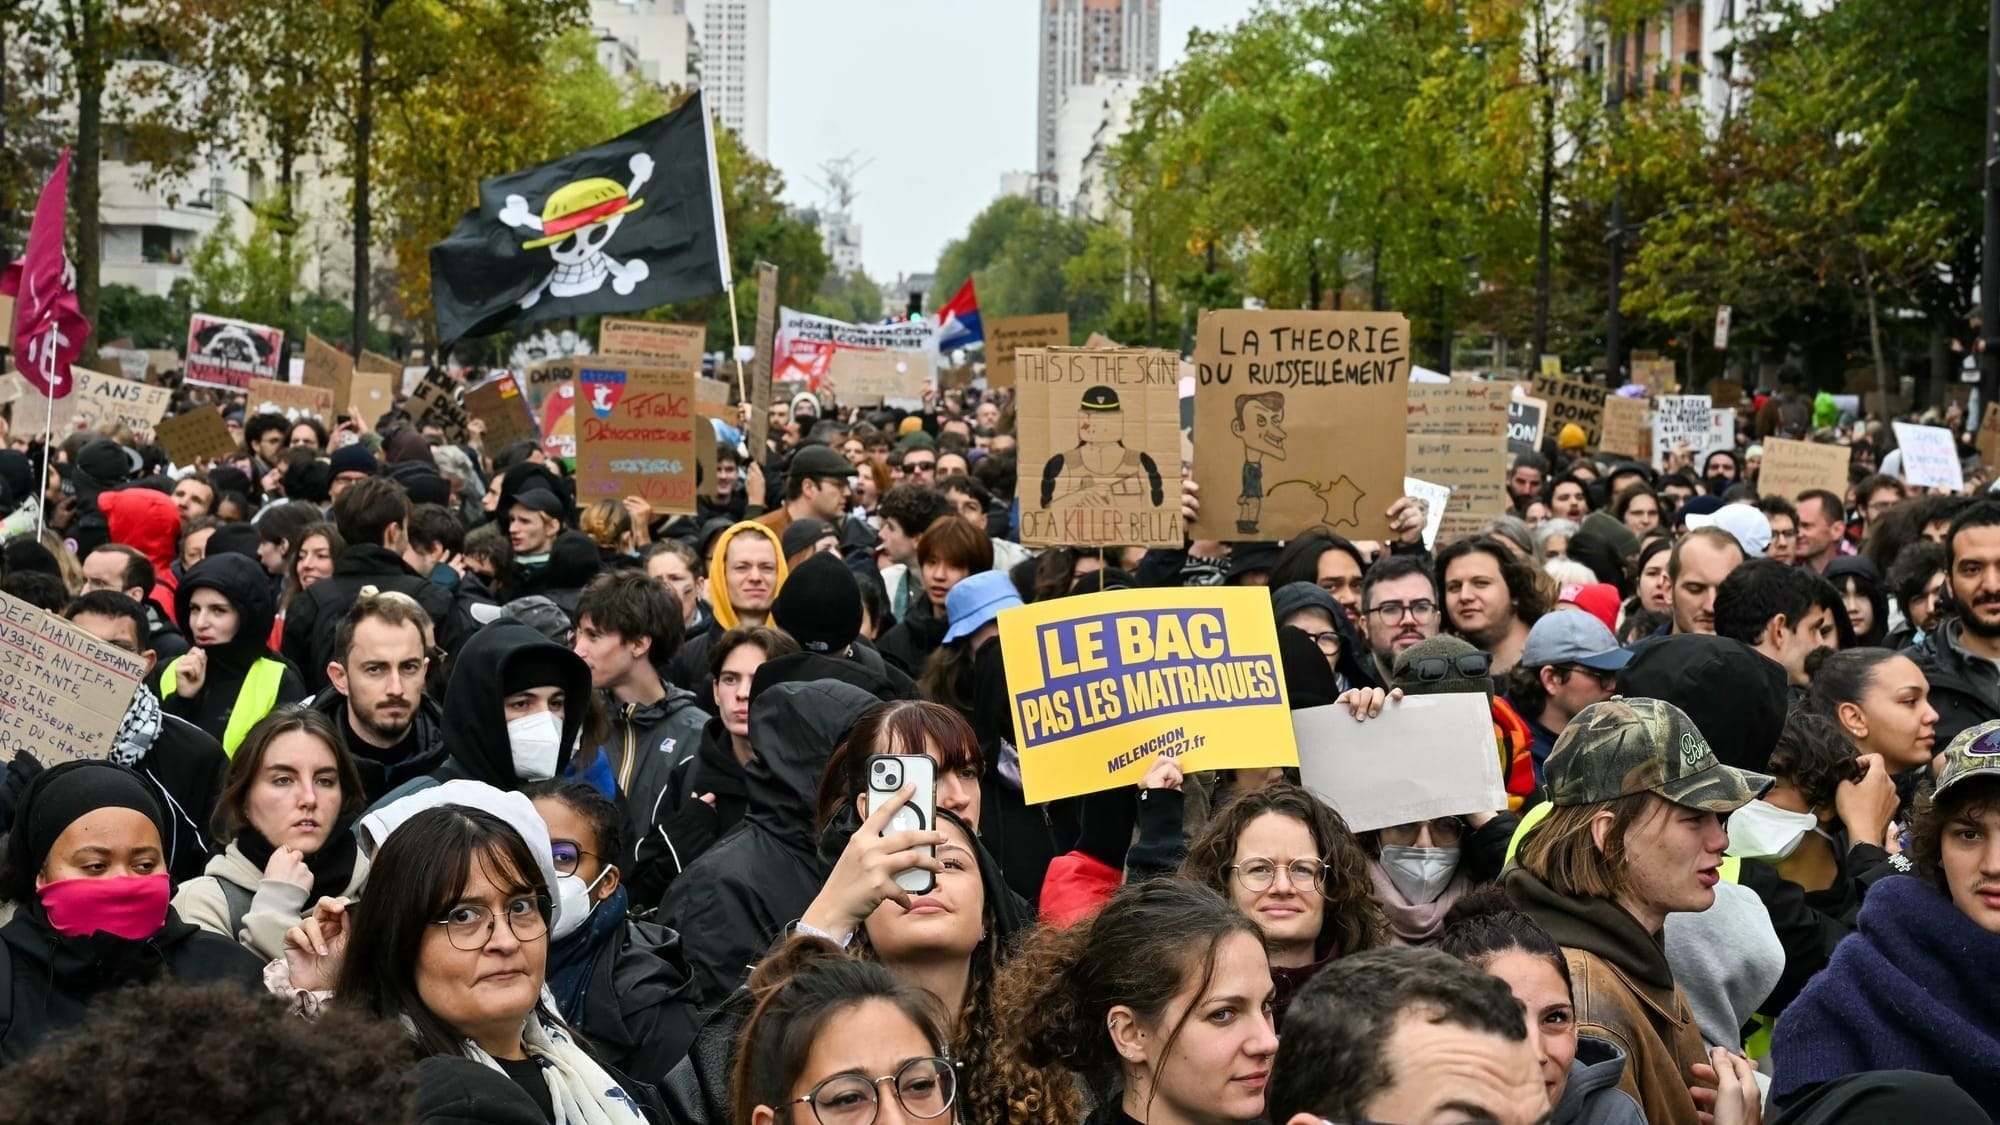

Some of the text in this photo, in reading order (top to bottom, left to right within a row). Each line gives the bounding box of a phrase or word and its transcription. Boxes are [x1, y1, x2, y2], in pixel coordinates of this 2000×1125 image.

[837, 334, 923, 348] CONSTRUIRE
[1220, 326, 1400, 356] LA THEORIE
[1018, 354, 1179, 384] THIS IS THE SKIN
[1200, 357, 1405, 388] DU RUISSELLEMENT
[95, 380, 141, 401] ANS
[1553, 402, 1602, 424] DONC
[1022, 509, 1179, 543] OF A KILLER BELLA
[40, 619, 144, 677] MANIFESTANTE
[1044, 613, 1225, 679] LE BAC
[3, 650, 81, 700] SISTANTE,
[51, 653, 117, 694] ANTIFA,
[1021, 660, 1276, 741] PAS LES MATRAQUES
[29, 724, 45, 740] DU
[1107, 726, 1185, 774] MELENCHON
